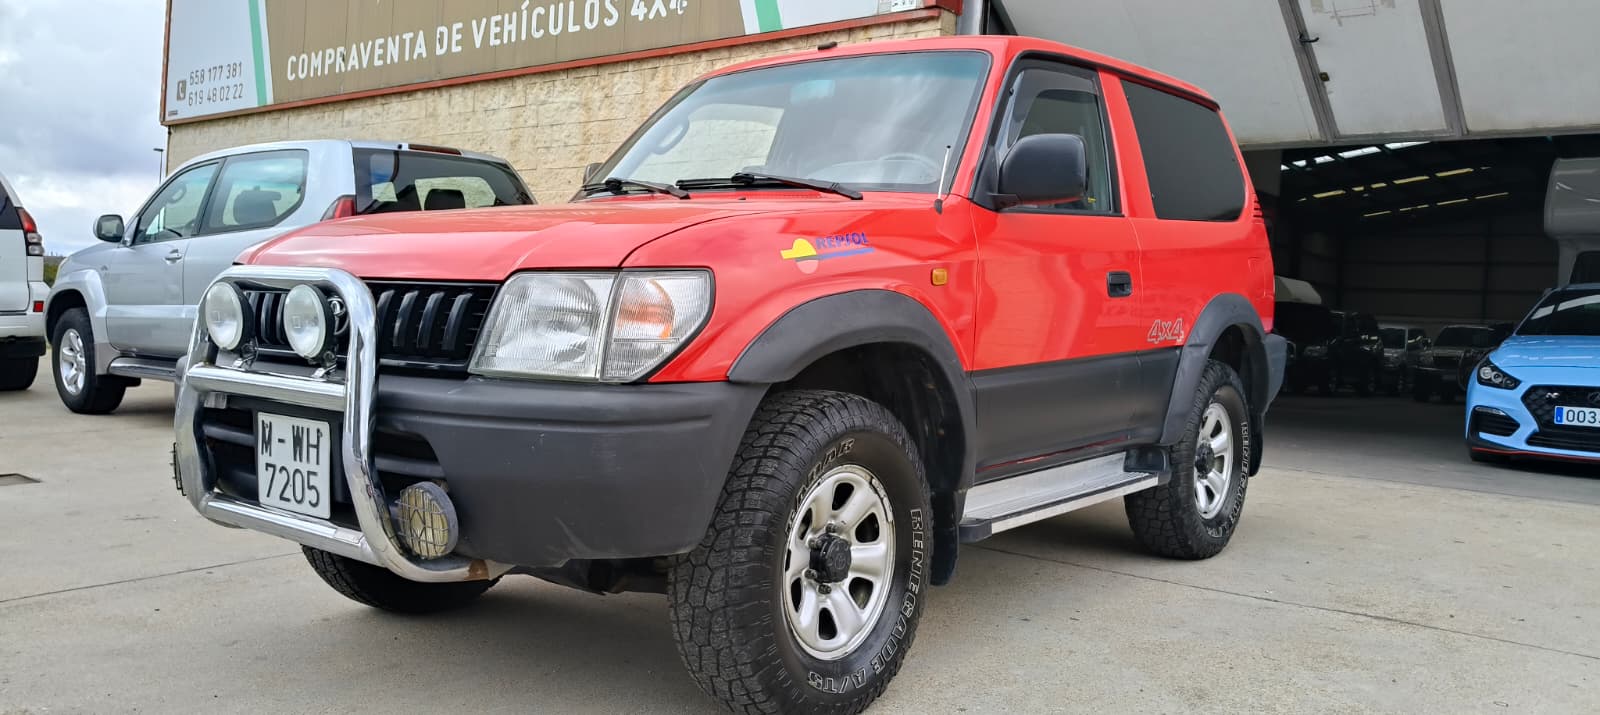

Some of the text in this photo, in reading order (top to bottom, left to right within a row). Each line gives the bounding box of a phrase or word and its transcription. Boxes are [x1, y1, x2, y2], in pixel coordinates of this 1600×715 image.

[287, 30, 427, 81] COMPRAVENTA
[435, 22, 463, 56] DE
[471, 0, 619, 48] VEHÍCULOS
[189, 62, 242, 86] 658 177 381
[188, 83, 244, 106] 619 48 02 22
[1566, 409, 1600, 424] 003
[265, 462, 320, 508] 7205
[871, 508, 924, 674] RENEGADE
